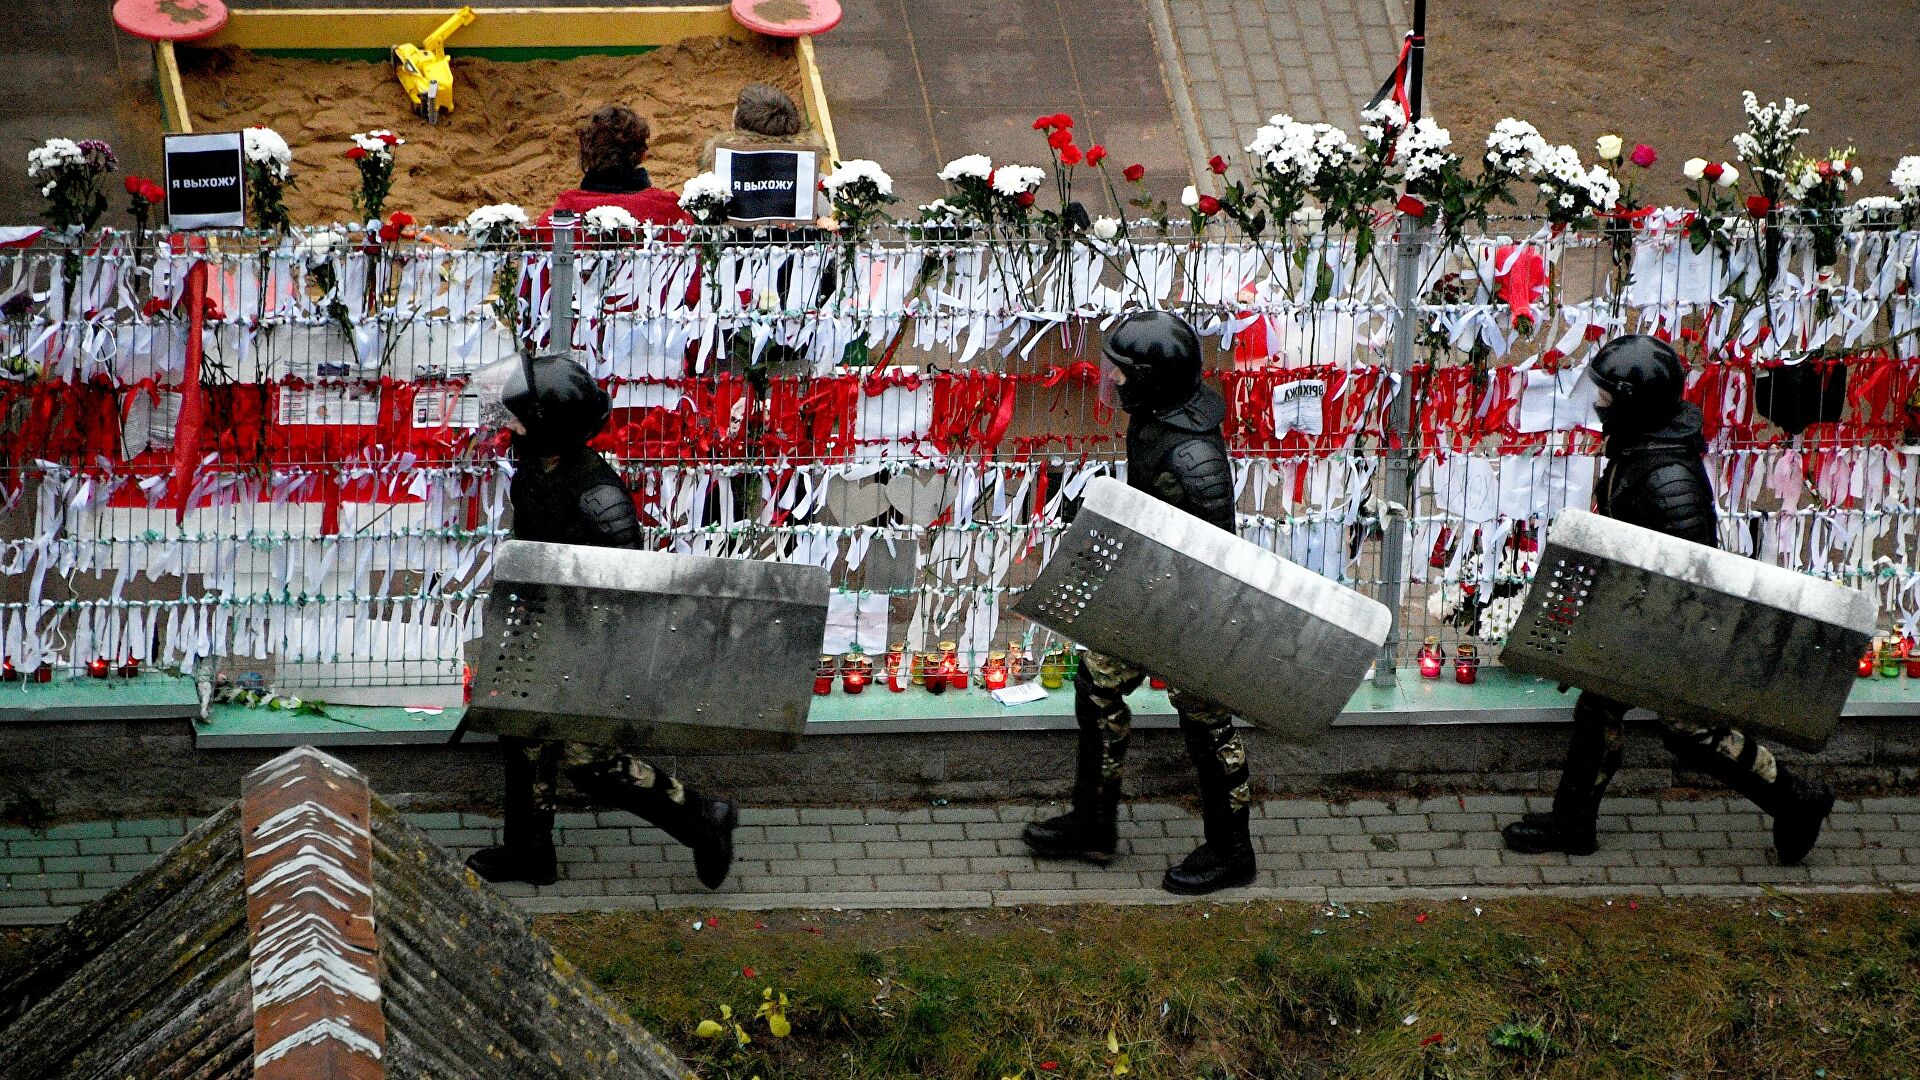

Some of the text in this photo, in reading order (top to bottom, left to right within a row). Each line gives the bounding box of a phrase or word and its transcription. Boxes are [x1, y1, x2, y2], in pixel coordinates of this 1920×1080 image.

[172, 176, 237, 189] Я ВЫХОЖУ
[733, 179, 794, 191] Я ВЫХОЖУ
